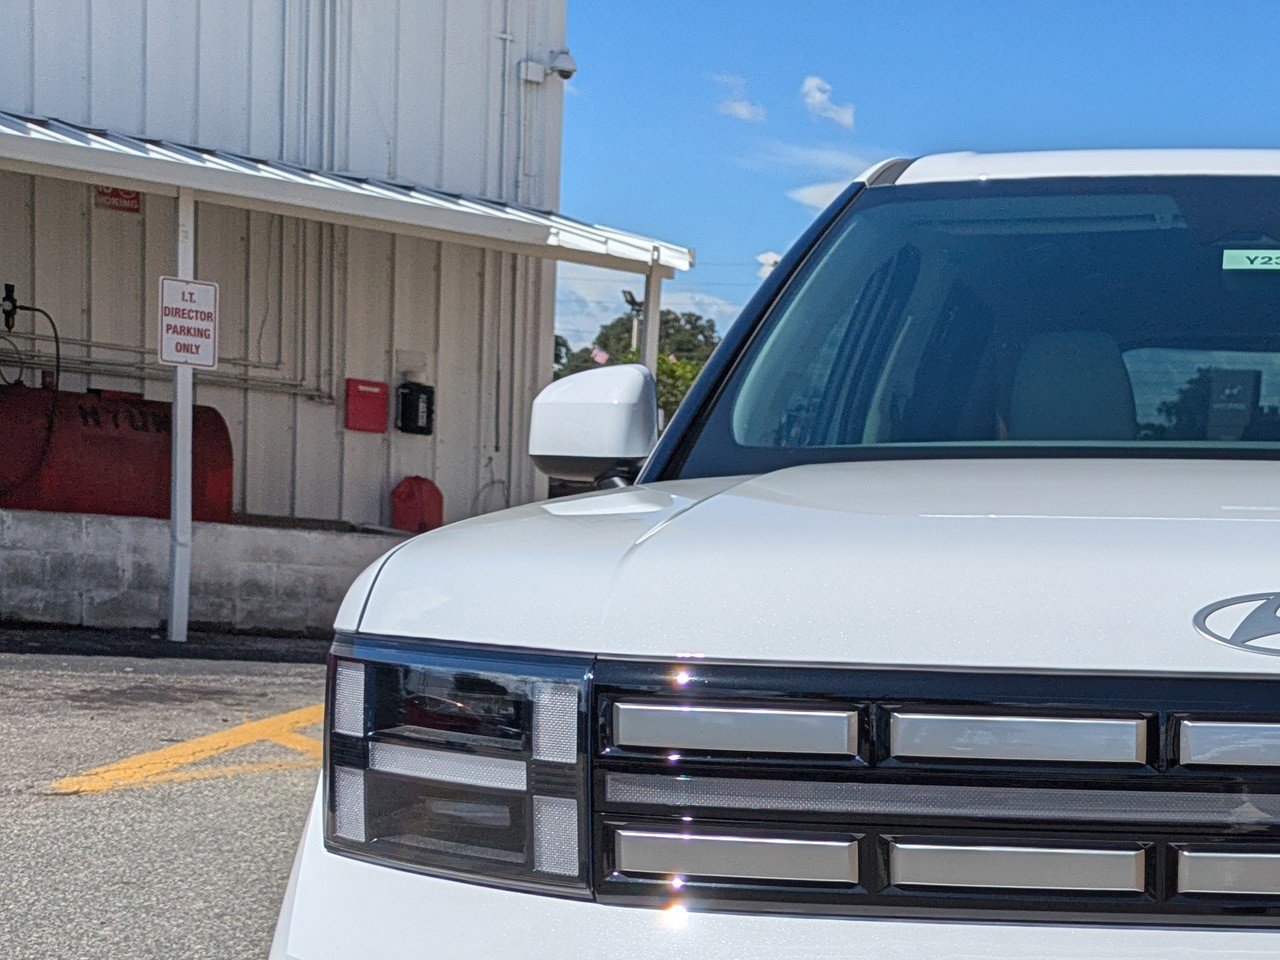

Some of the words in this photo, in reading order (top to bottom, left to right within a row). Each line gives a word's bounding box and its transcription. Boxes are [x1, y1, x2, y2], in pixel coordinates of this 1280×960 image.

[181, 291, 196, 303] I.T.
[164, 306, 214, 322] DIRECTOR
[165, 323, 211, 339] PARKING
[175, 341, 201, 355] ONLY
